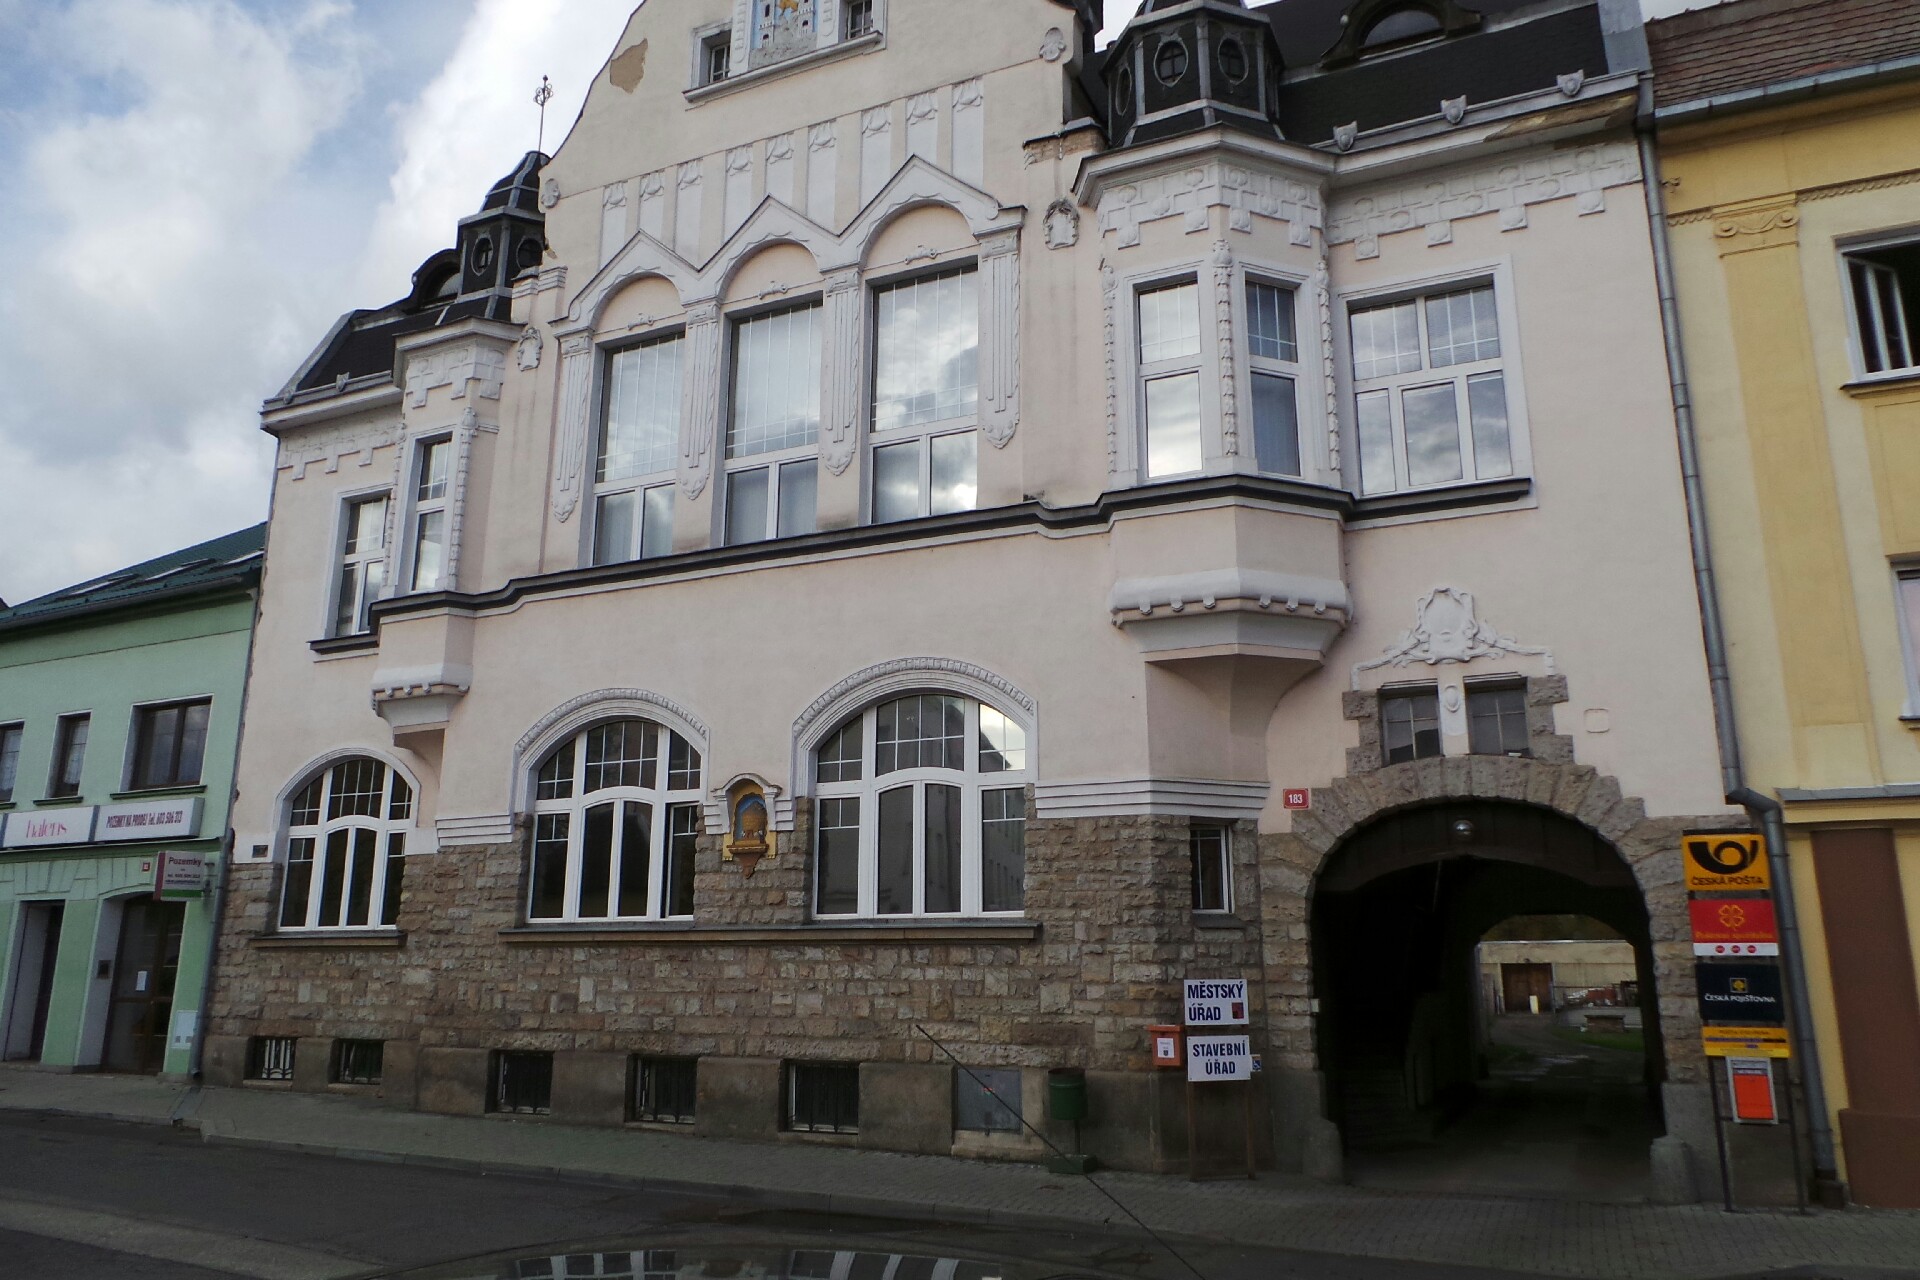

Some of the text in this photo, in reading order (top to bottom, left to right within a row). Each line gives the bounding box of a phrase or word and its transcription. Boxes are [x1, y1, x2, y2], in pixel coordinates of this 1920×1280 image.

[1288, 794, 1303, 804] 183
[169, 857, 202, 867] Pozemky
[1692, 875, 1764, 886] ČESKÁ POŠTA
[1188, 981, 1243, 998] MĚSTSKÝ
[1704, 993, 1776, 1003] ČESKÁ POJIŠŤOVNA
[1189, 1003, 1221, 1021] ÚŘAD
[1193, 1040, 1246, 1057] STAVEBNÍ
[1205, 1059, 1236, 1075] ÚŘAD
